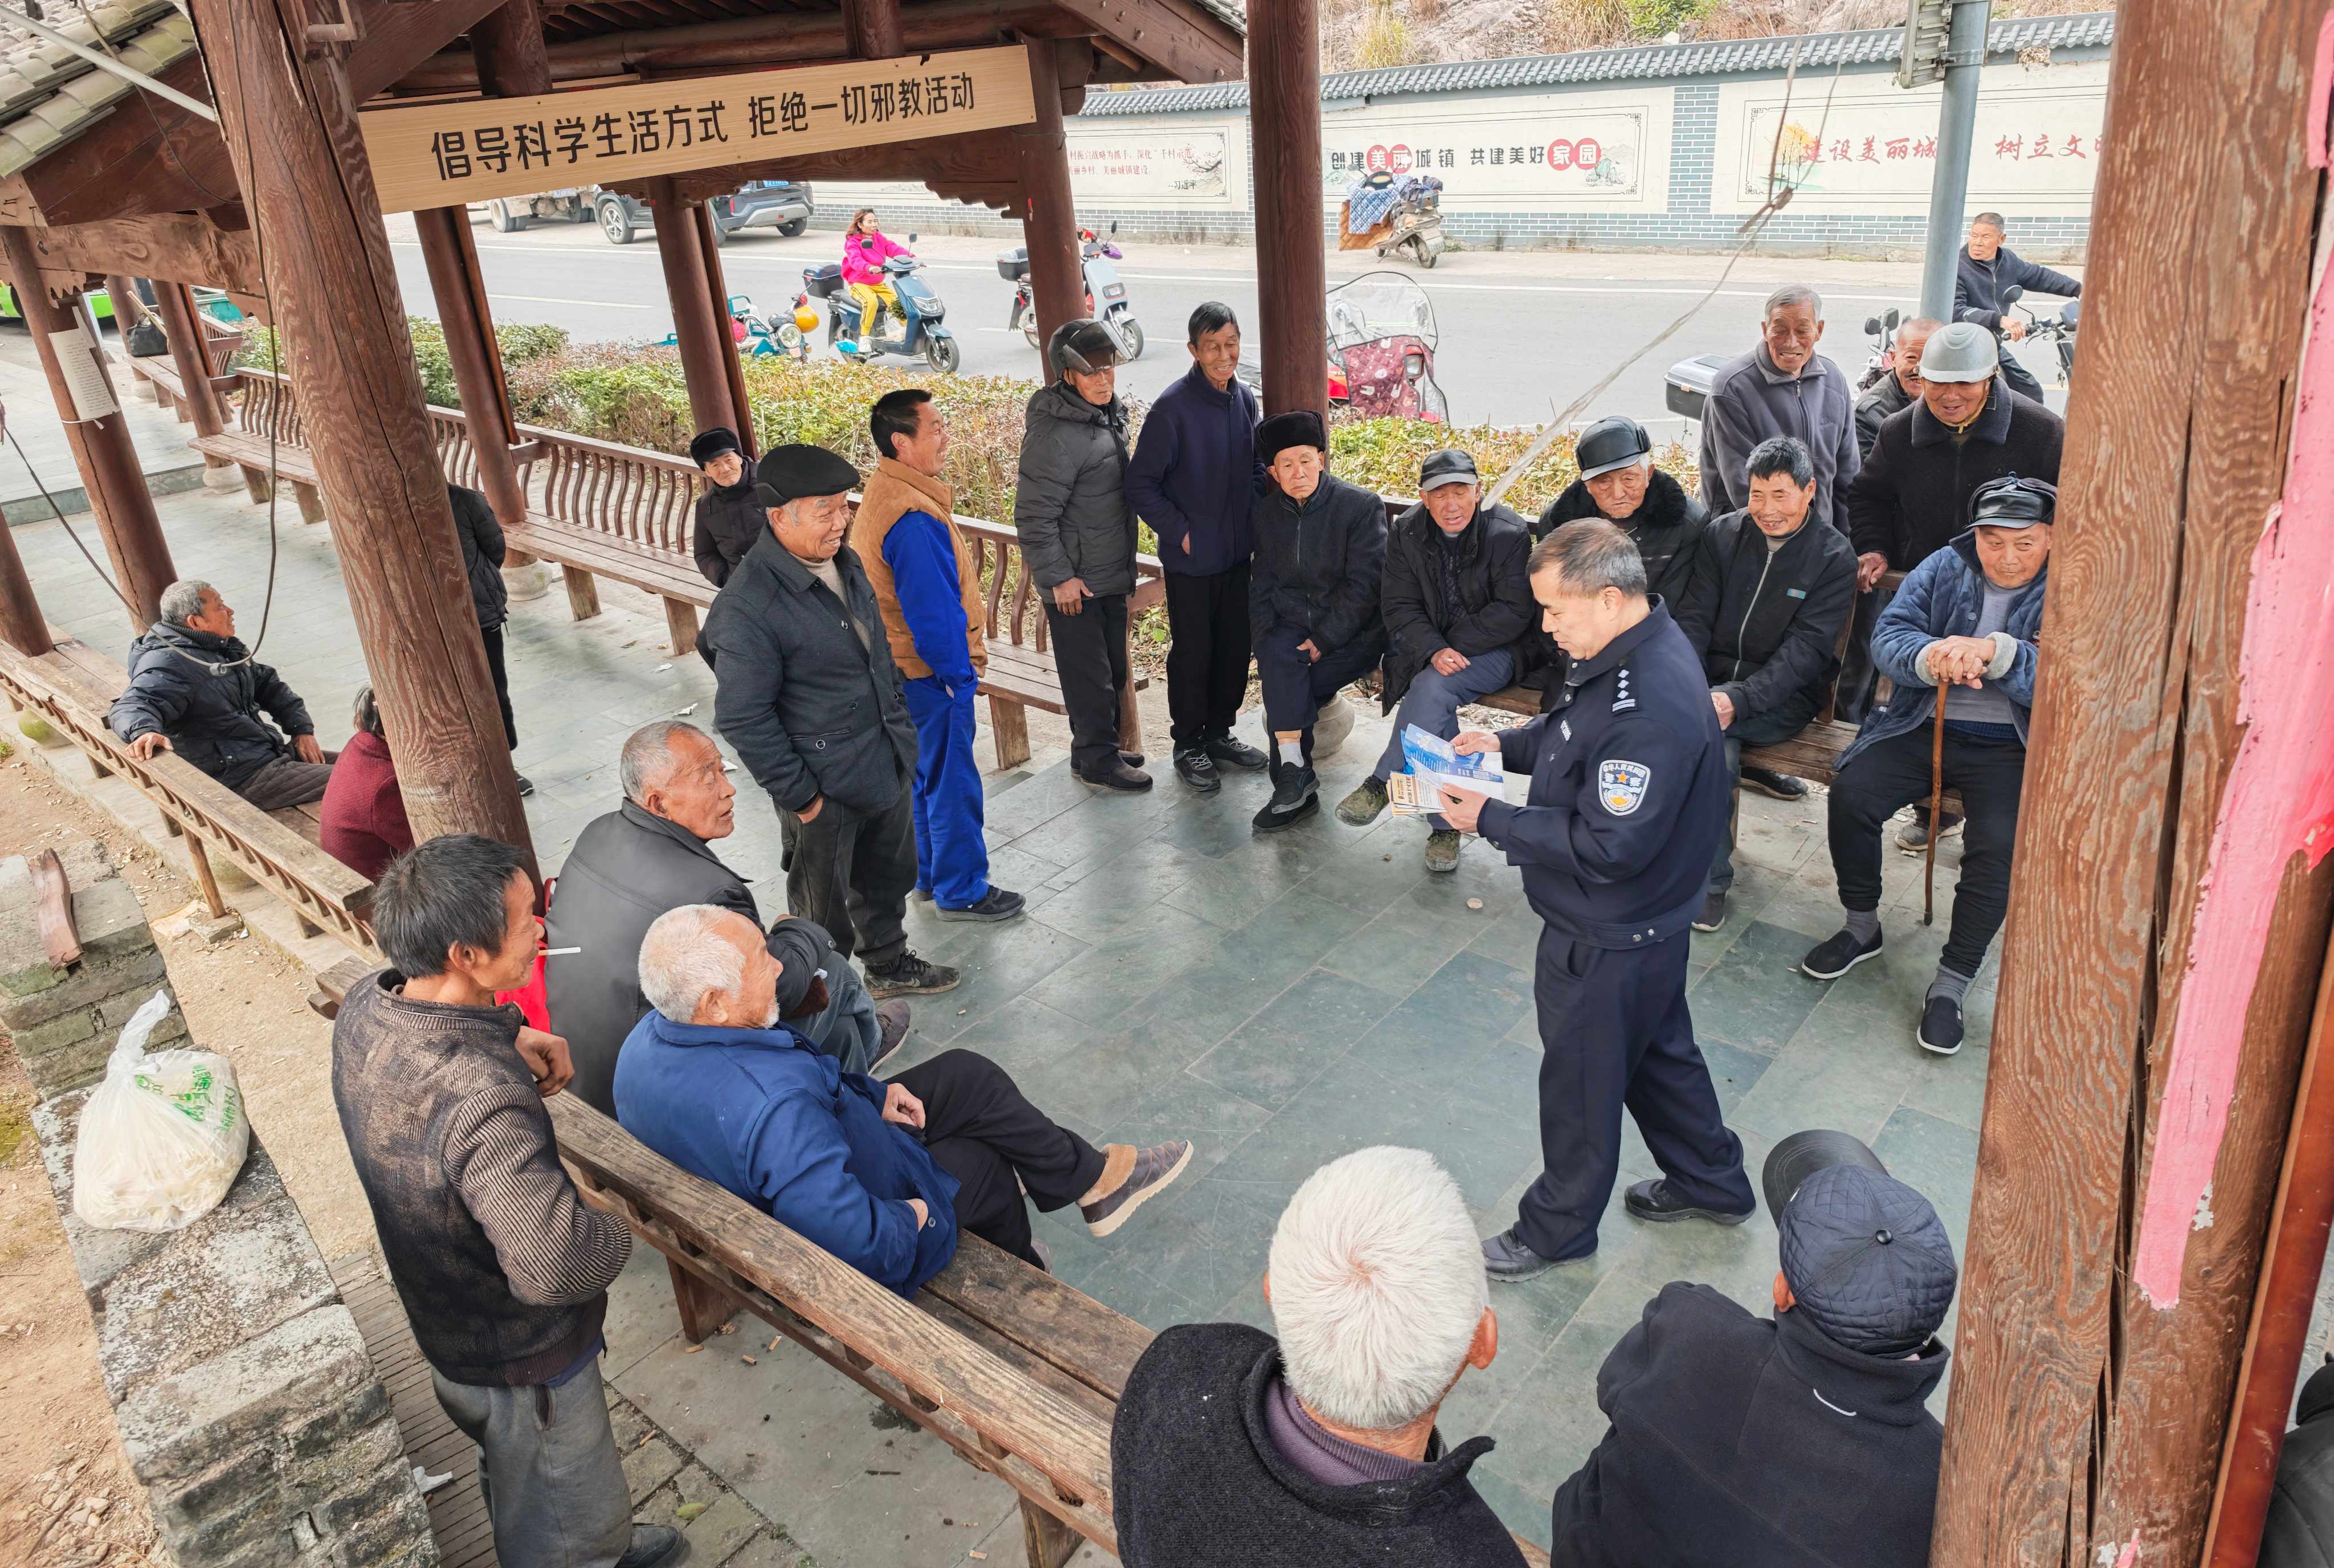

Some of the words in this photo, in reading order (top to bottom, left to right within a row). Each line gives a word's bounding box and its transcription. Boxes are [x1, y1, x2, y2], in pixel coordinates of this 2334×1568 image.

[431, 100, 728, 181] 倡导科学生活方式
[749, 73, 974, 138] 拒绝一切邪教活动
[1332, 149, 1454, 169] 创建美丽城镇
[1471, 145, 1597, 164] 共建美好家园
